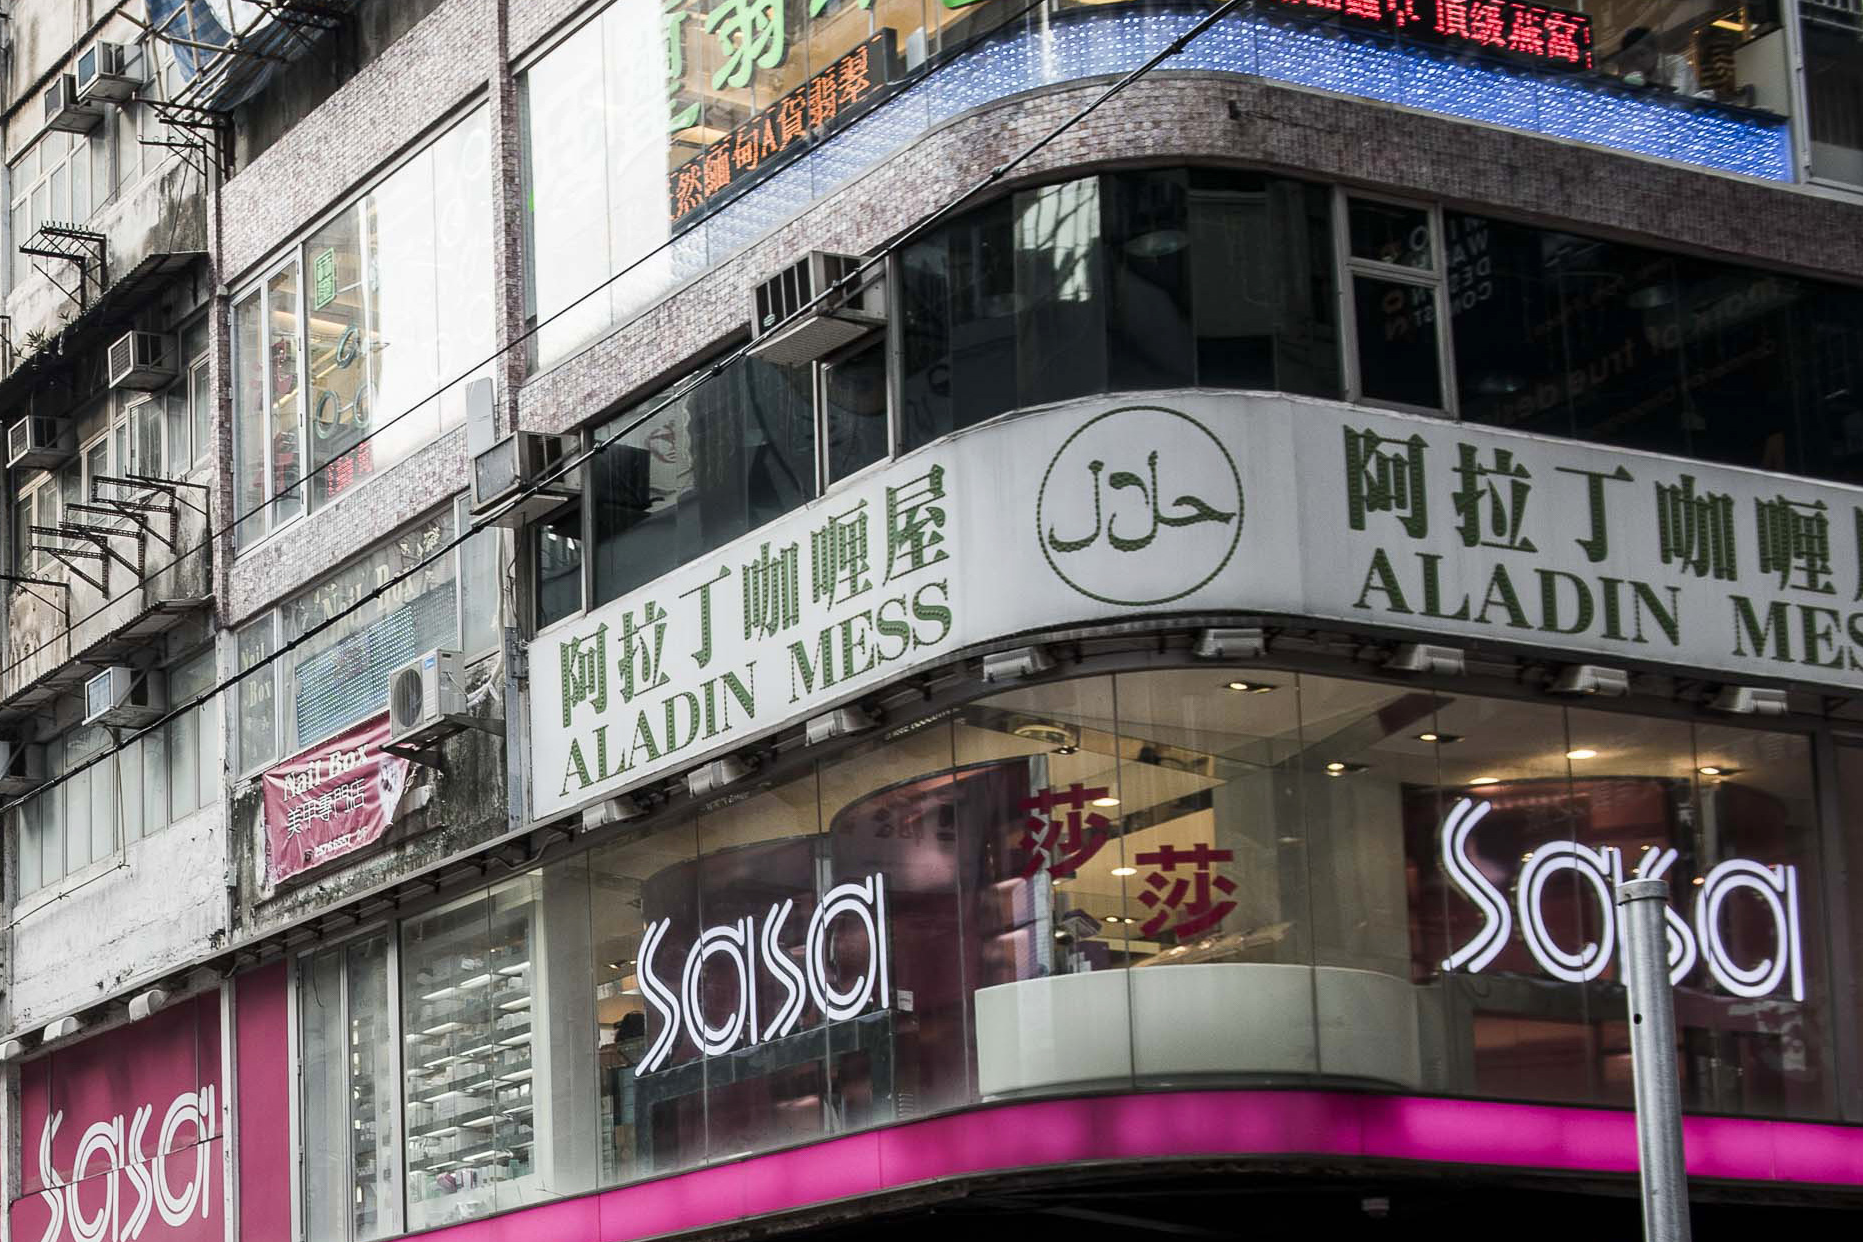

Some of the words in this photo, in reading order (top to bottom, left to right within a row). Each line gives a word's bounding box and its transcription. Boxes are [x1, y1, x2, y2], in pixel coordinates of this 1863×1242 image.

[668, 45, 870, 221] 然緬甸A貨翡翠
[560, 464, 949, 728] 阿拉丁咖喱屋
[1343, 424, 1863, 602] 阿拉丁咖喱
[1354, 547, 1682, 646] ALADIN
[283, 759, 322, 802] Nail
[329, 744, 369, 779] Box
[560, 661, 759, 797] ALADIN
[788, 580, 953, 704] MESS
